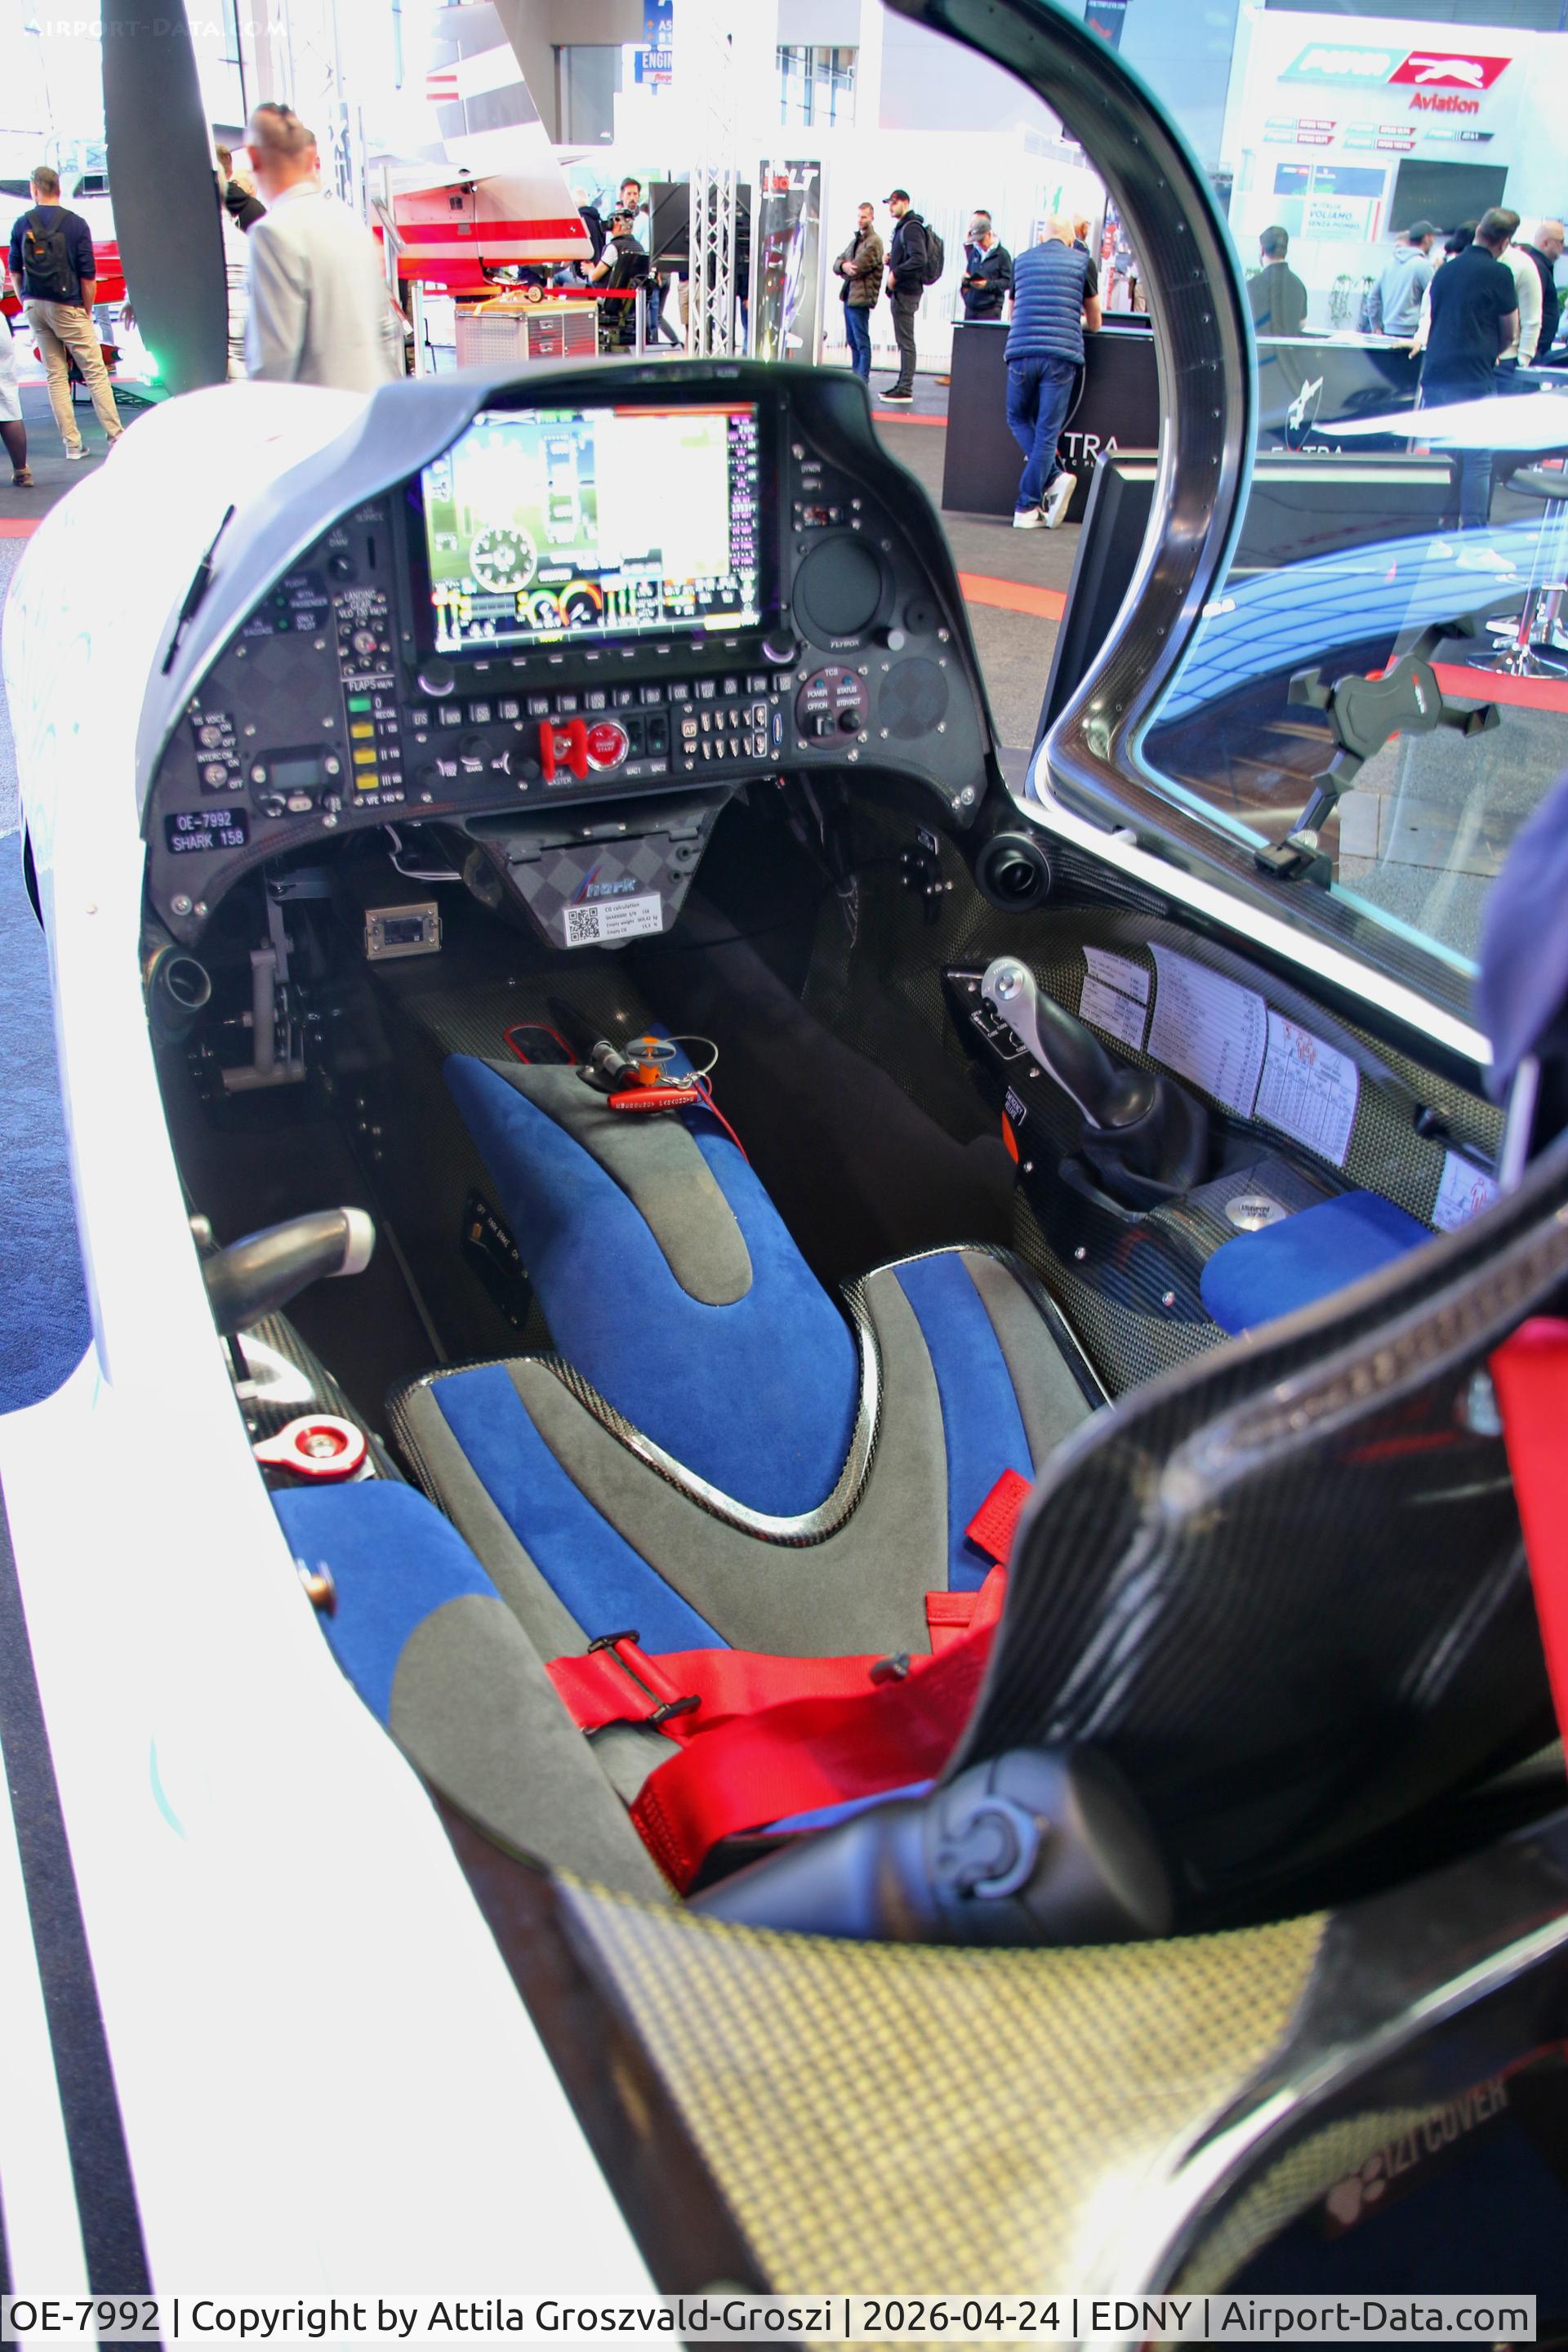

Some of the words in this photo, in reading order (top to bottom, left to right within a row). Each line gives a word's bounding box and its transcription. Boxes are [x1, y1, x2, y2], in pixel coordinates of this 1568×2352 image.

[1409, 92, 1480, 114] Aviation
[830, 639, 860, 649] FLYBOX
[349, 679, 376, 693] FLAPS
[807, 688, 828, 699] POWER
[836, 685, 858, 696] STATUS
[176, 812, 232, 831] OE-7992
[172, 833, 213, 852] SHARK
[220, 829, 244, 846] 158
[612, 902, 639, 912] calculation
[1005, 1090, 1024, 1116] EMERGENCY
[1423, 2074, 1509, 2153] COVER
